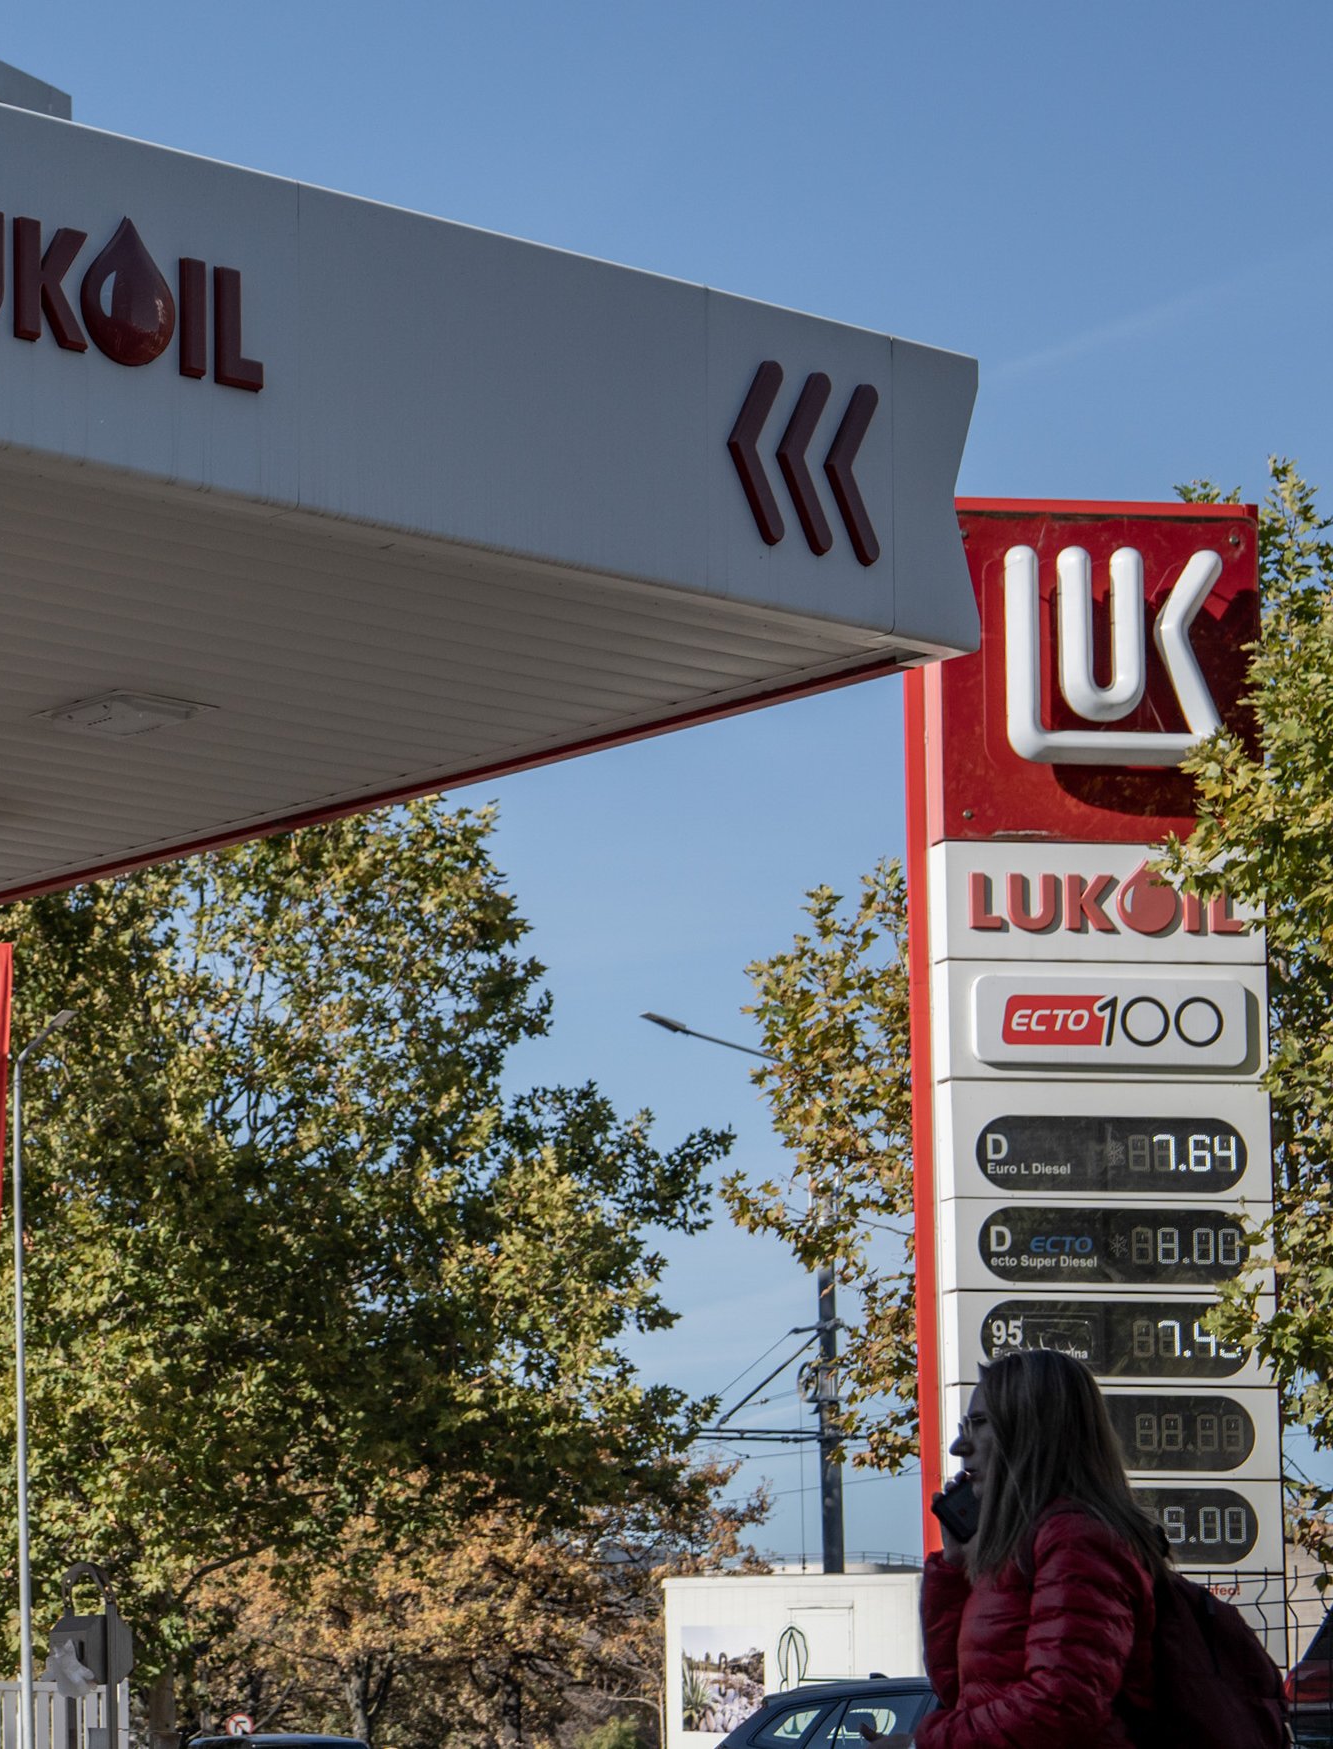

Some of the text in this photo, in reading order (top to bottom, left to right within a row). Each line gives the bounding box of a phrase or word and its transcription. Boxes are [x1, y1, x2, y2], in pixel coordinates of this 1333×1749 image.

[986, 1133, 1237, 1172] D 7.64
[987, 1162, 1071, 1175] Euro L Diesel
[990, 1225, 1240, 1265] D ECTO 8.00
[991, 1254, 1098, 1270] ecto Super Diesel
[992, 1319, 1023, 1346] 95
